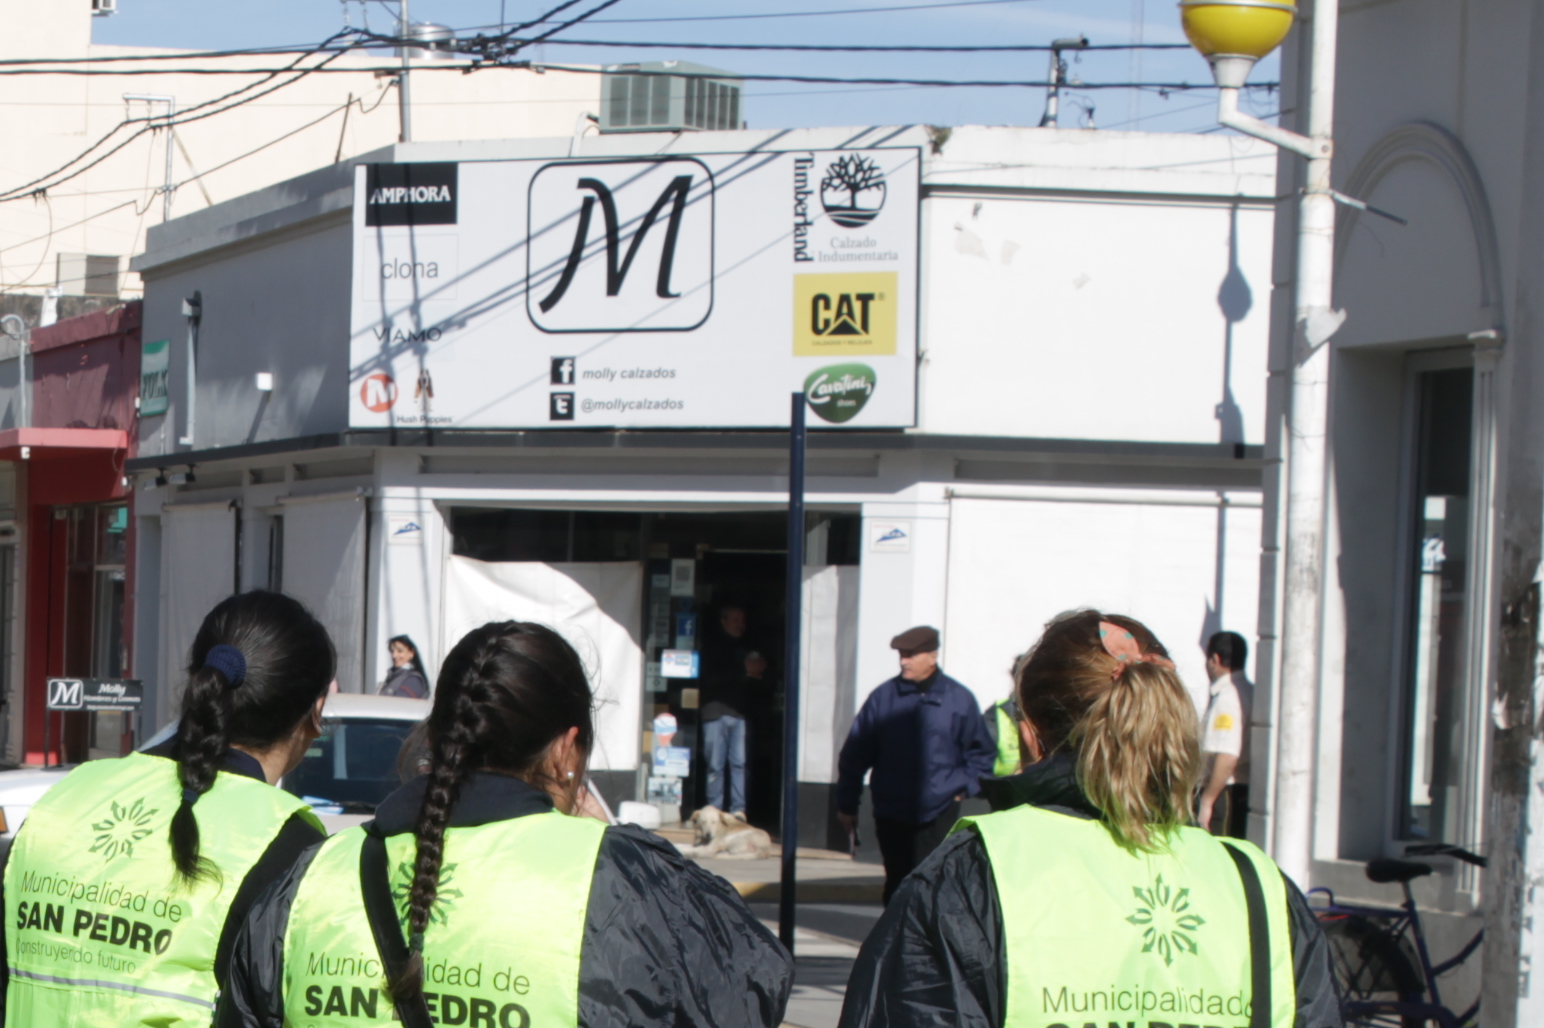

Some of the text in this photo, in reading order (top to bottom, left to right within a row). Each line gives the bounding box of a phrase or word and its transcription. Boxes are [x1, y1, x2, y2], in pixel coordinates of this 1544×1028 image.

[369, 185, 451, 204] AMPHORA
[793, 153, 814, 263] Timberland
[538, 174, 694, 314] M
[817, 249, 899, 263] Indumentaria
[830, 236, 877, 249] Calzado
[381, 257, 438, 279] clona
[811, 292, 876, 336] CAT
[372, 327, 442, 343] VIAMO
[582, 366, 677, 382] molly calzados
[581, 397, 684, 413] @mollycalzados
[51, 682, 127, 705] M Molly
[21, 870, 182, 922] Municipalidad de
[16, 901, 173, 956] SAN PEDRO
[15, 937, 136, 975] Construyendo futuro
[493, 966, 530, 995] de
[304, 984, 379, 1019] SAN
[1042, 984, 1243, 1018] Municipalidad
